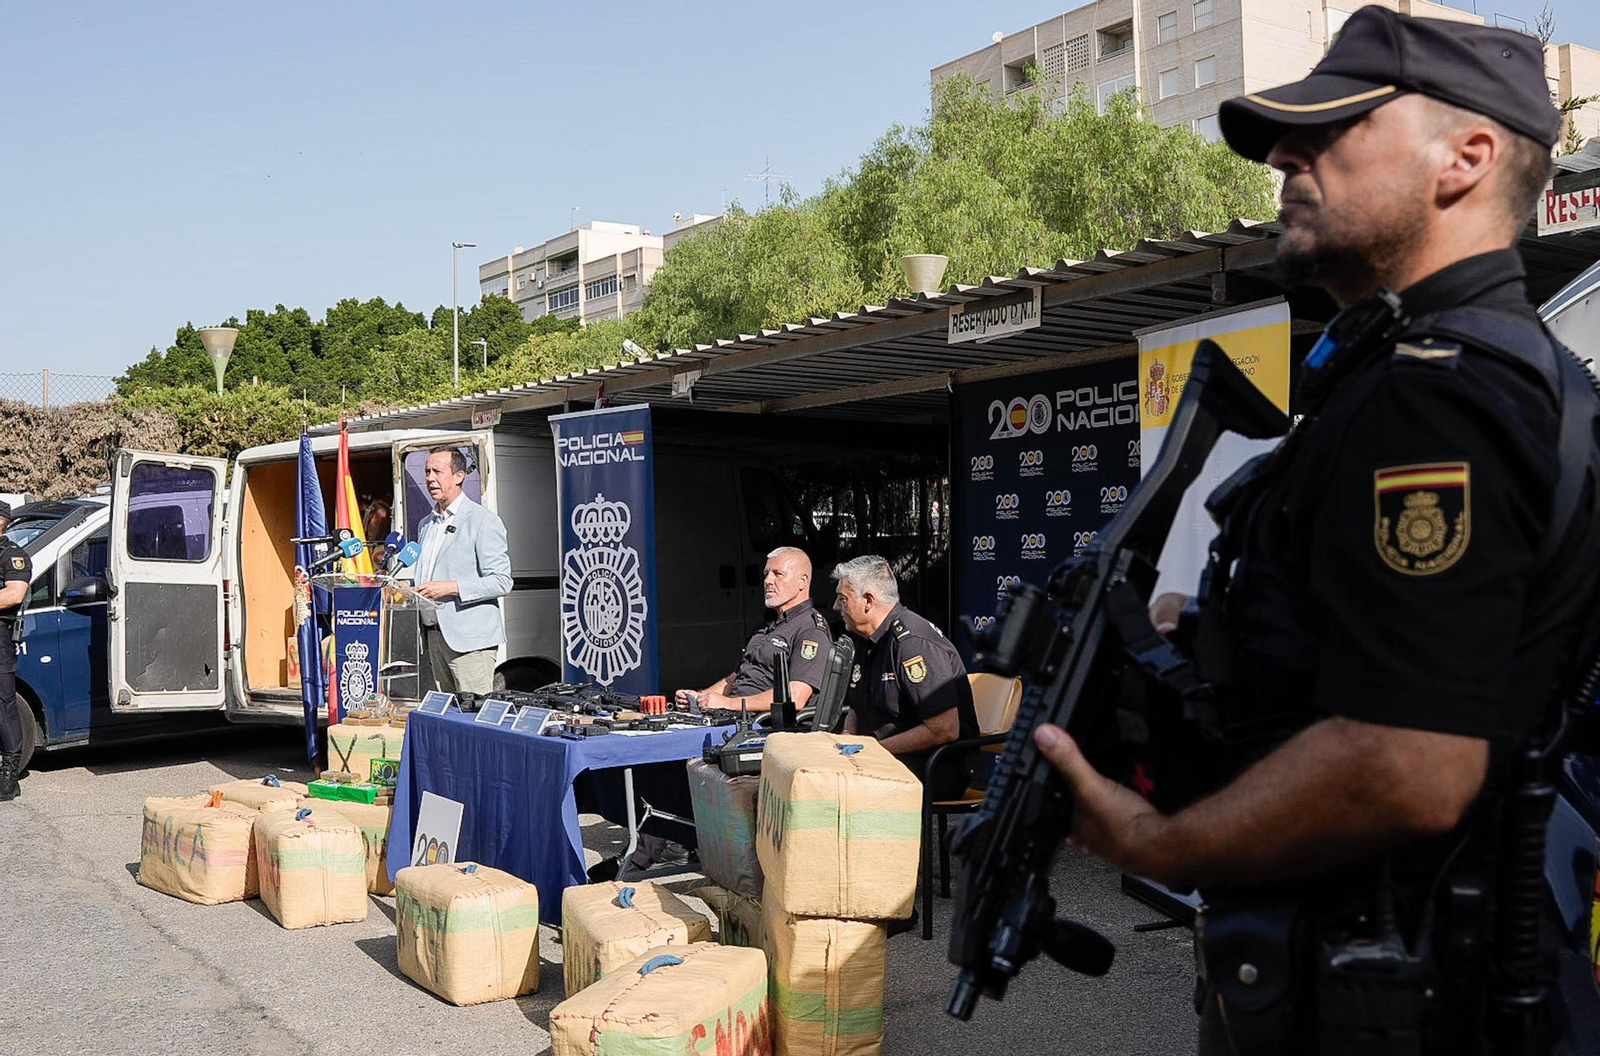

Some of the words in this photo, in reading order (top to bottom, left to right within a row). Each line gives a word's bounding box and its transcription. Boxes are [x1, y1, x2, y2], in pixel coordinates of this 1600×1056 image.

[952, 306, 1008, 334] RESERVADO
[1056, 380, 1138, 410] POLIC
[988, 394, 1053, 440] 200
[1056, 403, 1140, 432] NACIO
[557, 447, 645, 468] NACIONAL
[406, 545, 419, 559] tve
[336, 617, 378, 626] NACIONAL
[585, 628, 624, 648] NACIONAL
[414, 832, 449, 867] 200
